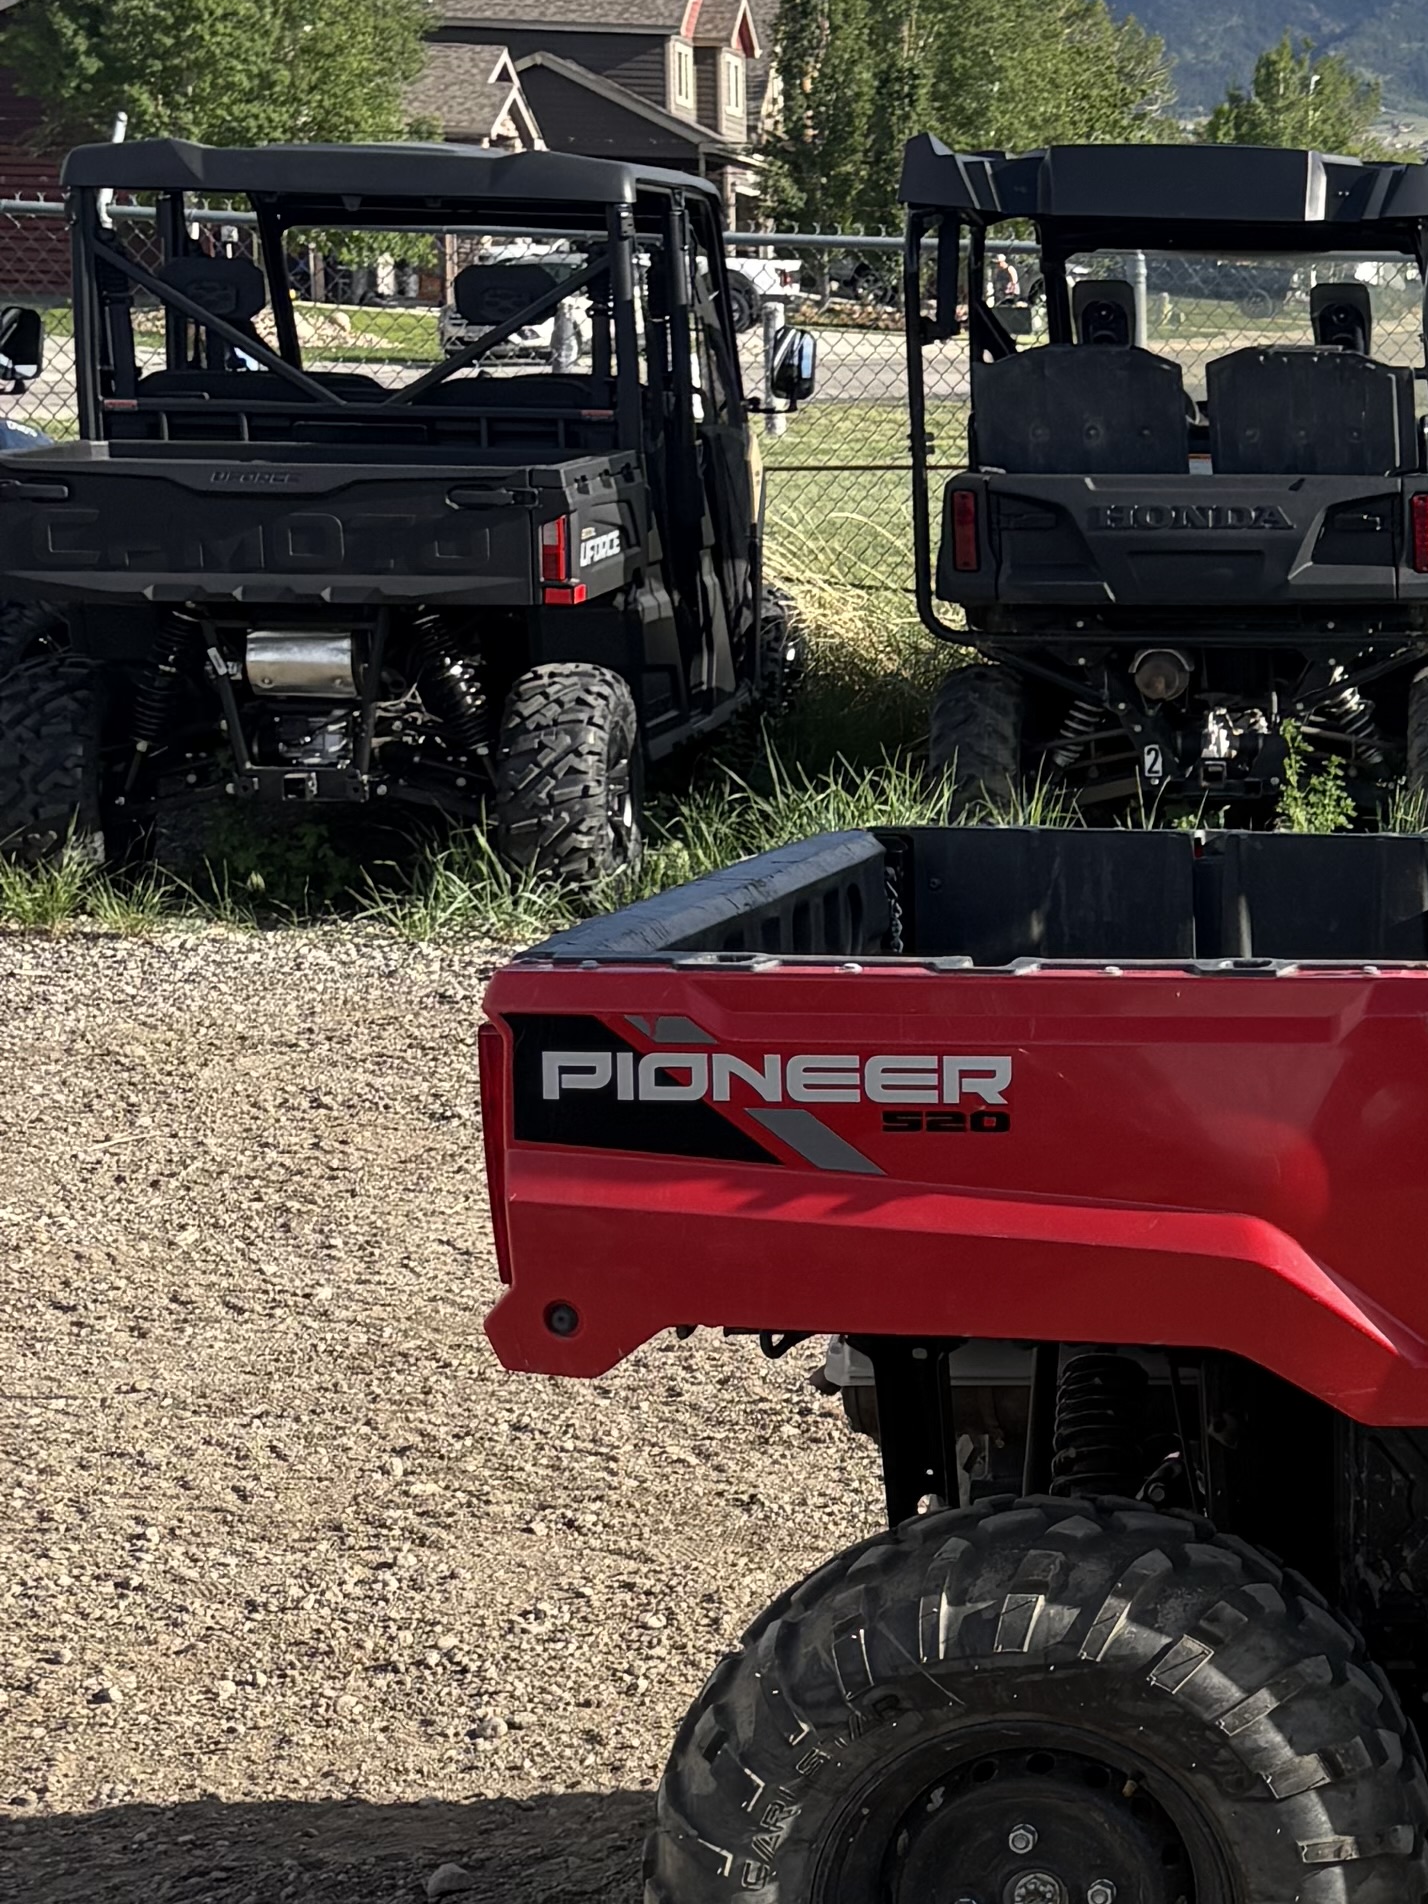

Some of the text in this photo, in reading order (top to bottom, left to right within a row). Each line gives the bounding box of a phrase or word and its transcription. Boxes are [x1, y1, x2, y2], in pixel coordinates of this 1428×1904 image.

[209, 469, 303, 486] UFORCE
[1087, 504, 1297, 531] HONDA
[579, 529, 620, 568] UFORCE
[1146, 748, 1160, 774] 2
[541, 1050, 1013, 1105] PIONEER
[881, 1110, 1011, 1134] 520
